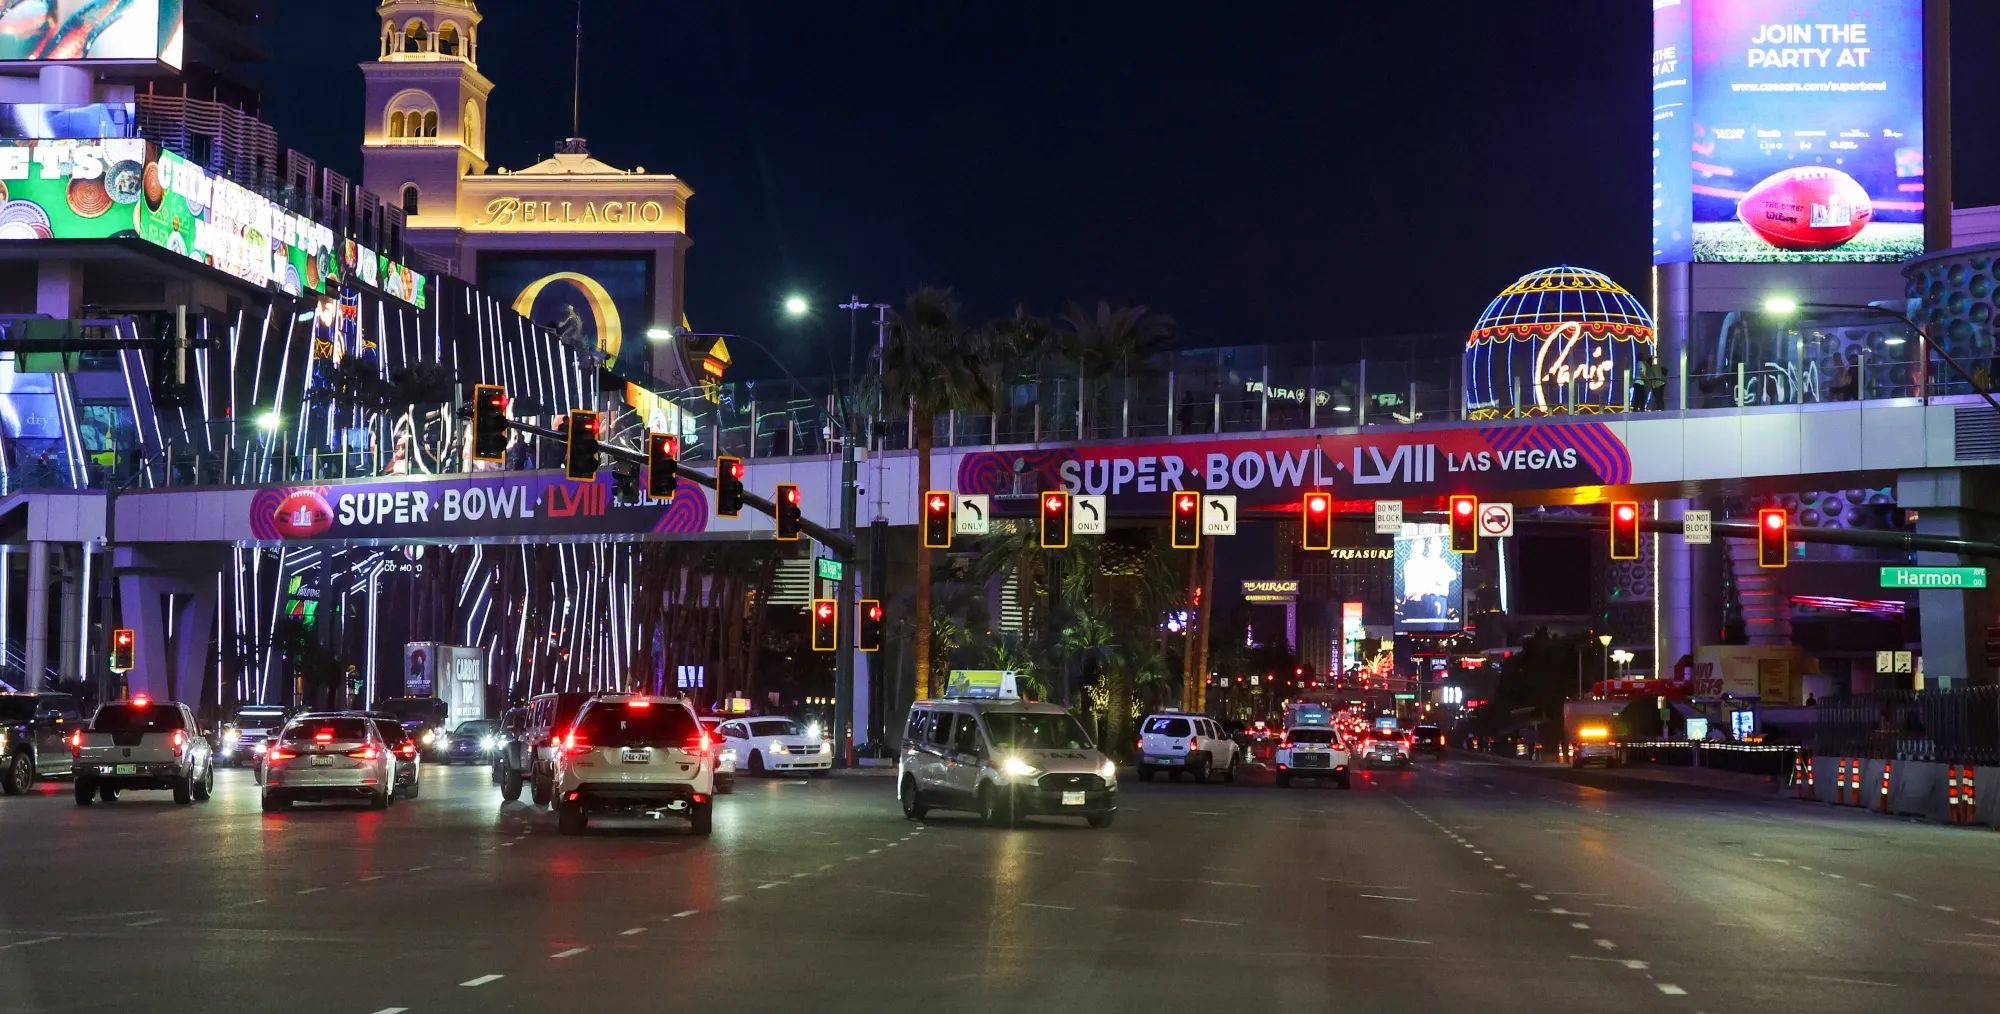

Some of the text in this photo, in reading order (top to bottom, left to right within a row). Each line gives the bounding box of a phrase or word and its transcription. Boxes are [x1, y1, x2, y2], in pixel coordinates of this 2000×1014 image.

[1751, 23, 1867, 44] JOIN THE
[1748, 48, 1870, 68] PARTY AT
[1059, 455, 1185, 496] SUPER
[1205, 448, 1335, 492] BOWL
[1353, 443, 1436, 485] LVIII
[1447, 451, 1492, 473] LAS
[1496, 447, 1578, 471] VEGAS
[338, 490, 429, 526] SUPER
[443, 484, 535, 522] BOWL
[547, 483, 606, 518] LVIII
[1377, 504, 1400, 512] DO NOT
[1377, 514, 1400, 522] BLOCK
[1685, 513, 1708, 521] DO NOT
[961, 522, 984, 530] ONLY
[1077, 522, 1100, 530] ONLY
[1208, 523, 1231, 531] ONLY
[1685, 524, 1709, 532] BLOCK
[1330, 549, 1394, 560] TREASURE
[1881, 568, 1985, 585] E Harmon AVE
[1249, 582, 1297, 592] MIRAGE
[456, 658, 480, 681] CARROT
[462, 681, 475, 704] TOP
